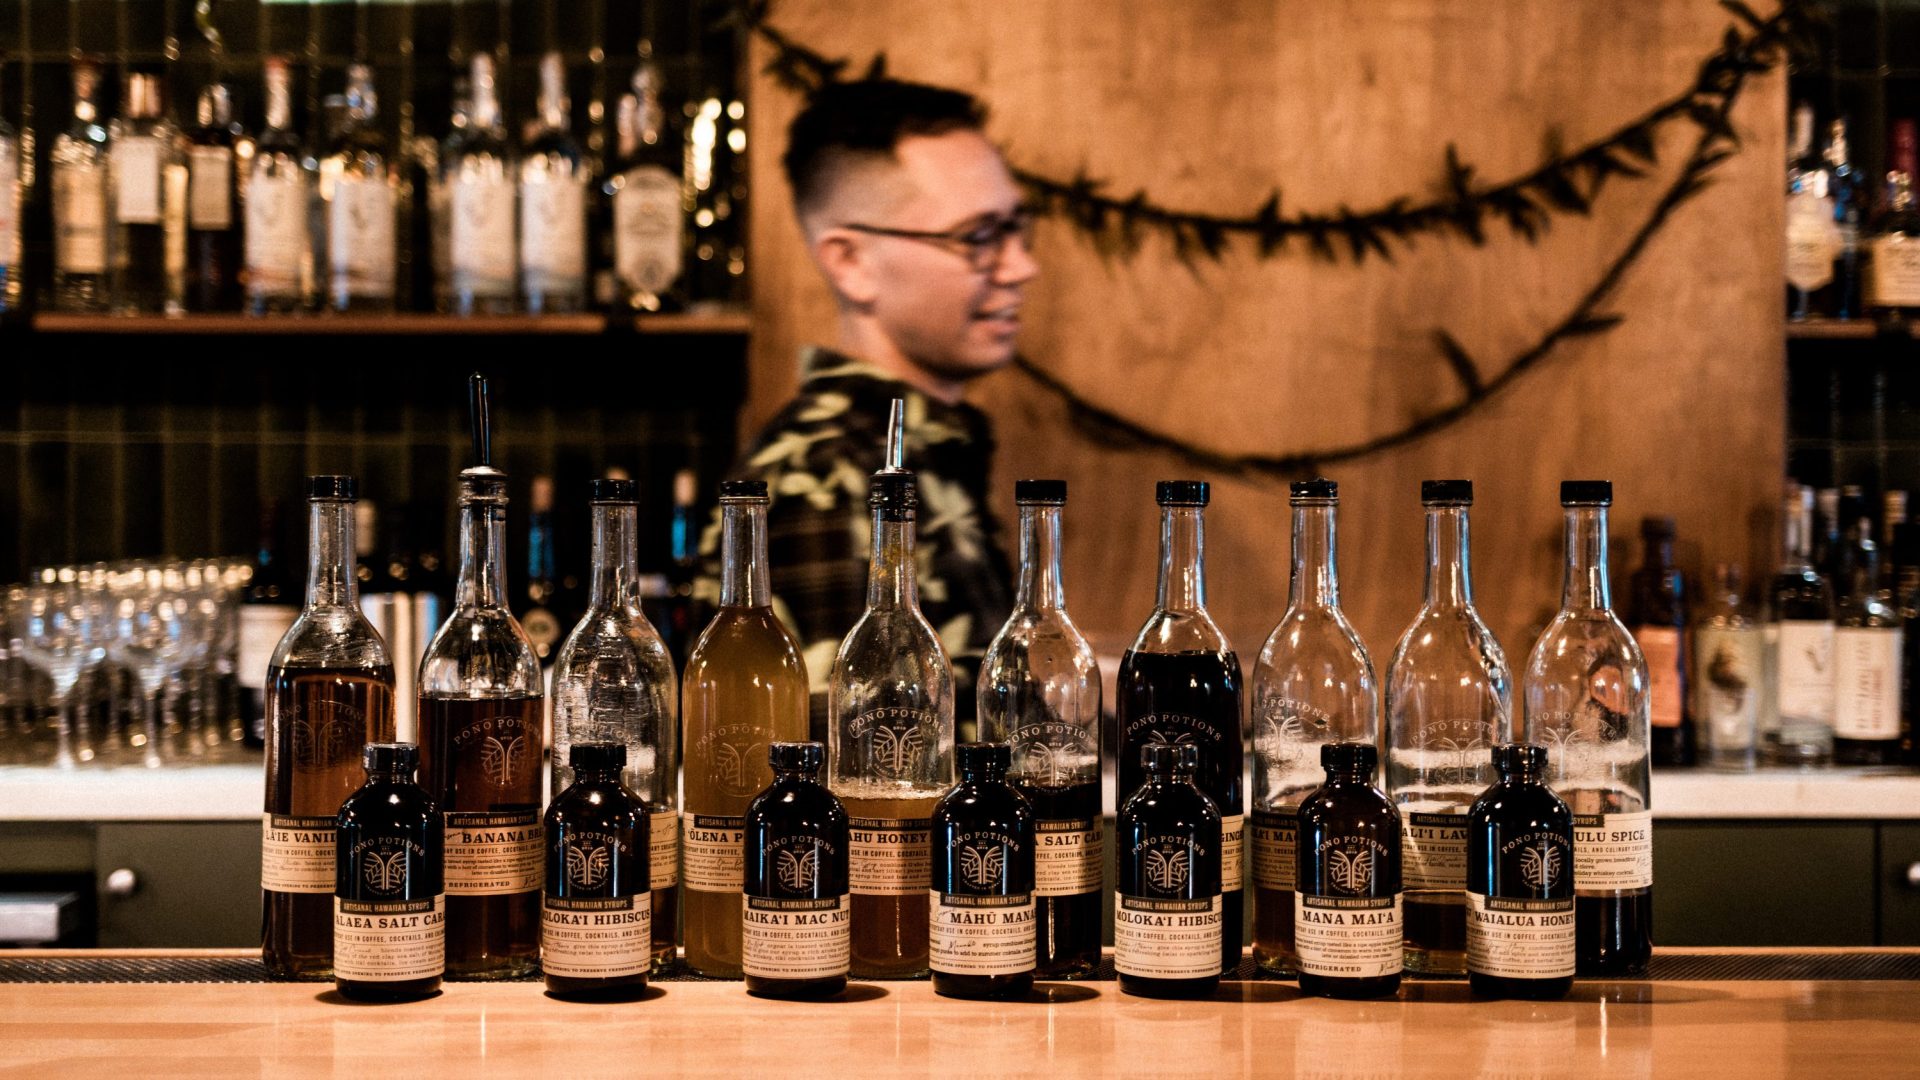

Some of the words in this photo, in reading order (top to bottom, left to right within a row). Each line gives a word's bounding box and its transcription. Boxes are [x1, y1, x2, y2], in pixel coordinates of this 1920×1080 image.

[1270, 699, 1330, 723] POTIONS
[850, 709, 885, 731] PONO
[891, 708, 944, 734] POTIONS
[1127, 714, 1157, 735] PONO
[1162, 714, 1220, 740] POTIONS
[454, 721, 492, 745] PONO
[1004, 727, 1040, 746] PONO
[454, 818, 488, 826] ARTISANAL
[462, 831, 524, 843] BANANA
[580, 831, 627, 852] POTIONS
[877, 833, 928, 843] HONEY
[975, 831, 1020, 852] POTIONS
[1045, 835, 1080, 845] SALT
[1575, 832, 1606, 842] ULU
[1612, 830, 1645, 841] SPICE
[378, 836, 425, 857] POTIONS
[791, 835, 835, 855] POTIONS
[1131, 837, 1157, 855] PONO
[1160, 835, 1205, 856] POTIONS
[1343, 835, 1389, 857] POTIONS
[1502, 834, 1531, 854] PONO
[572, 900, 602, 909] HAWAIIAN
[604, 900, 627, 908] SYRUPS
[752, 900, 779, 908] ARTISANAL
[782, 900, 813, 908] HAWAIIAN
[815, 899, 835, 907] SYRUPS
[945, 896, 975, 905] ARTISANAL
[978, 896, 1007, 905] HAWAIIAN
[1125, 900, 1153, 909] ARTISANAL
[1155, 902, 1186, 910] HAWAIIAN
[1188, 901, 1208, 910] SYRUPS
[1307, 897, 1336, 907] ARTISANAL
[1338, 899, 1369, 907] HAWAIIAN
[1371, 898, 1390, 907] SYRUPS
[1490, 900, 1524, 909] ARTISANAL
[344, 903, 372, 912] ARTISANAL
[375, 903, 406, 912] HAWAIIAN
[408, 902, 429, 911] SYRUPS
[378, 917, 418, 928] SALT
[594, 909, 650, 925] HIBISCUS
[795, 913, 827, 925] MAC
[832, 909, 849, 922] NUT
[950, 911, 996, 924] MĀHŪ
[1303, 910, 1344, 925] MANA
[1352, 912, 1394, 925] MAI‘A
[1475, 911, 1535, 926] WAIALUA
[389, 934, 423, 942] COCKTAILS,
[561, 931, 582, 940] COFFEE,
[770, 931, 793, 939] COFFEE,
[796, 931, 828, 939] COCKTAILS,
[1143, 932, 1166, 941] COFFEE,
[1326, 930, 1350, 938] COFFEE,
[1303, 963, 1362, 972] REFRIGERATED
